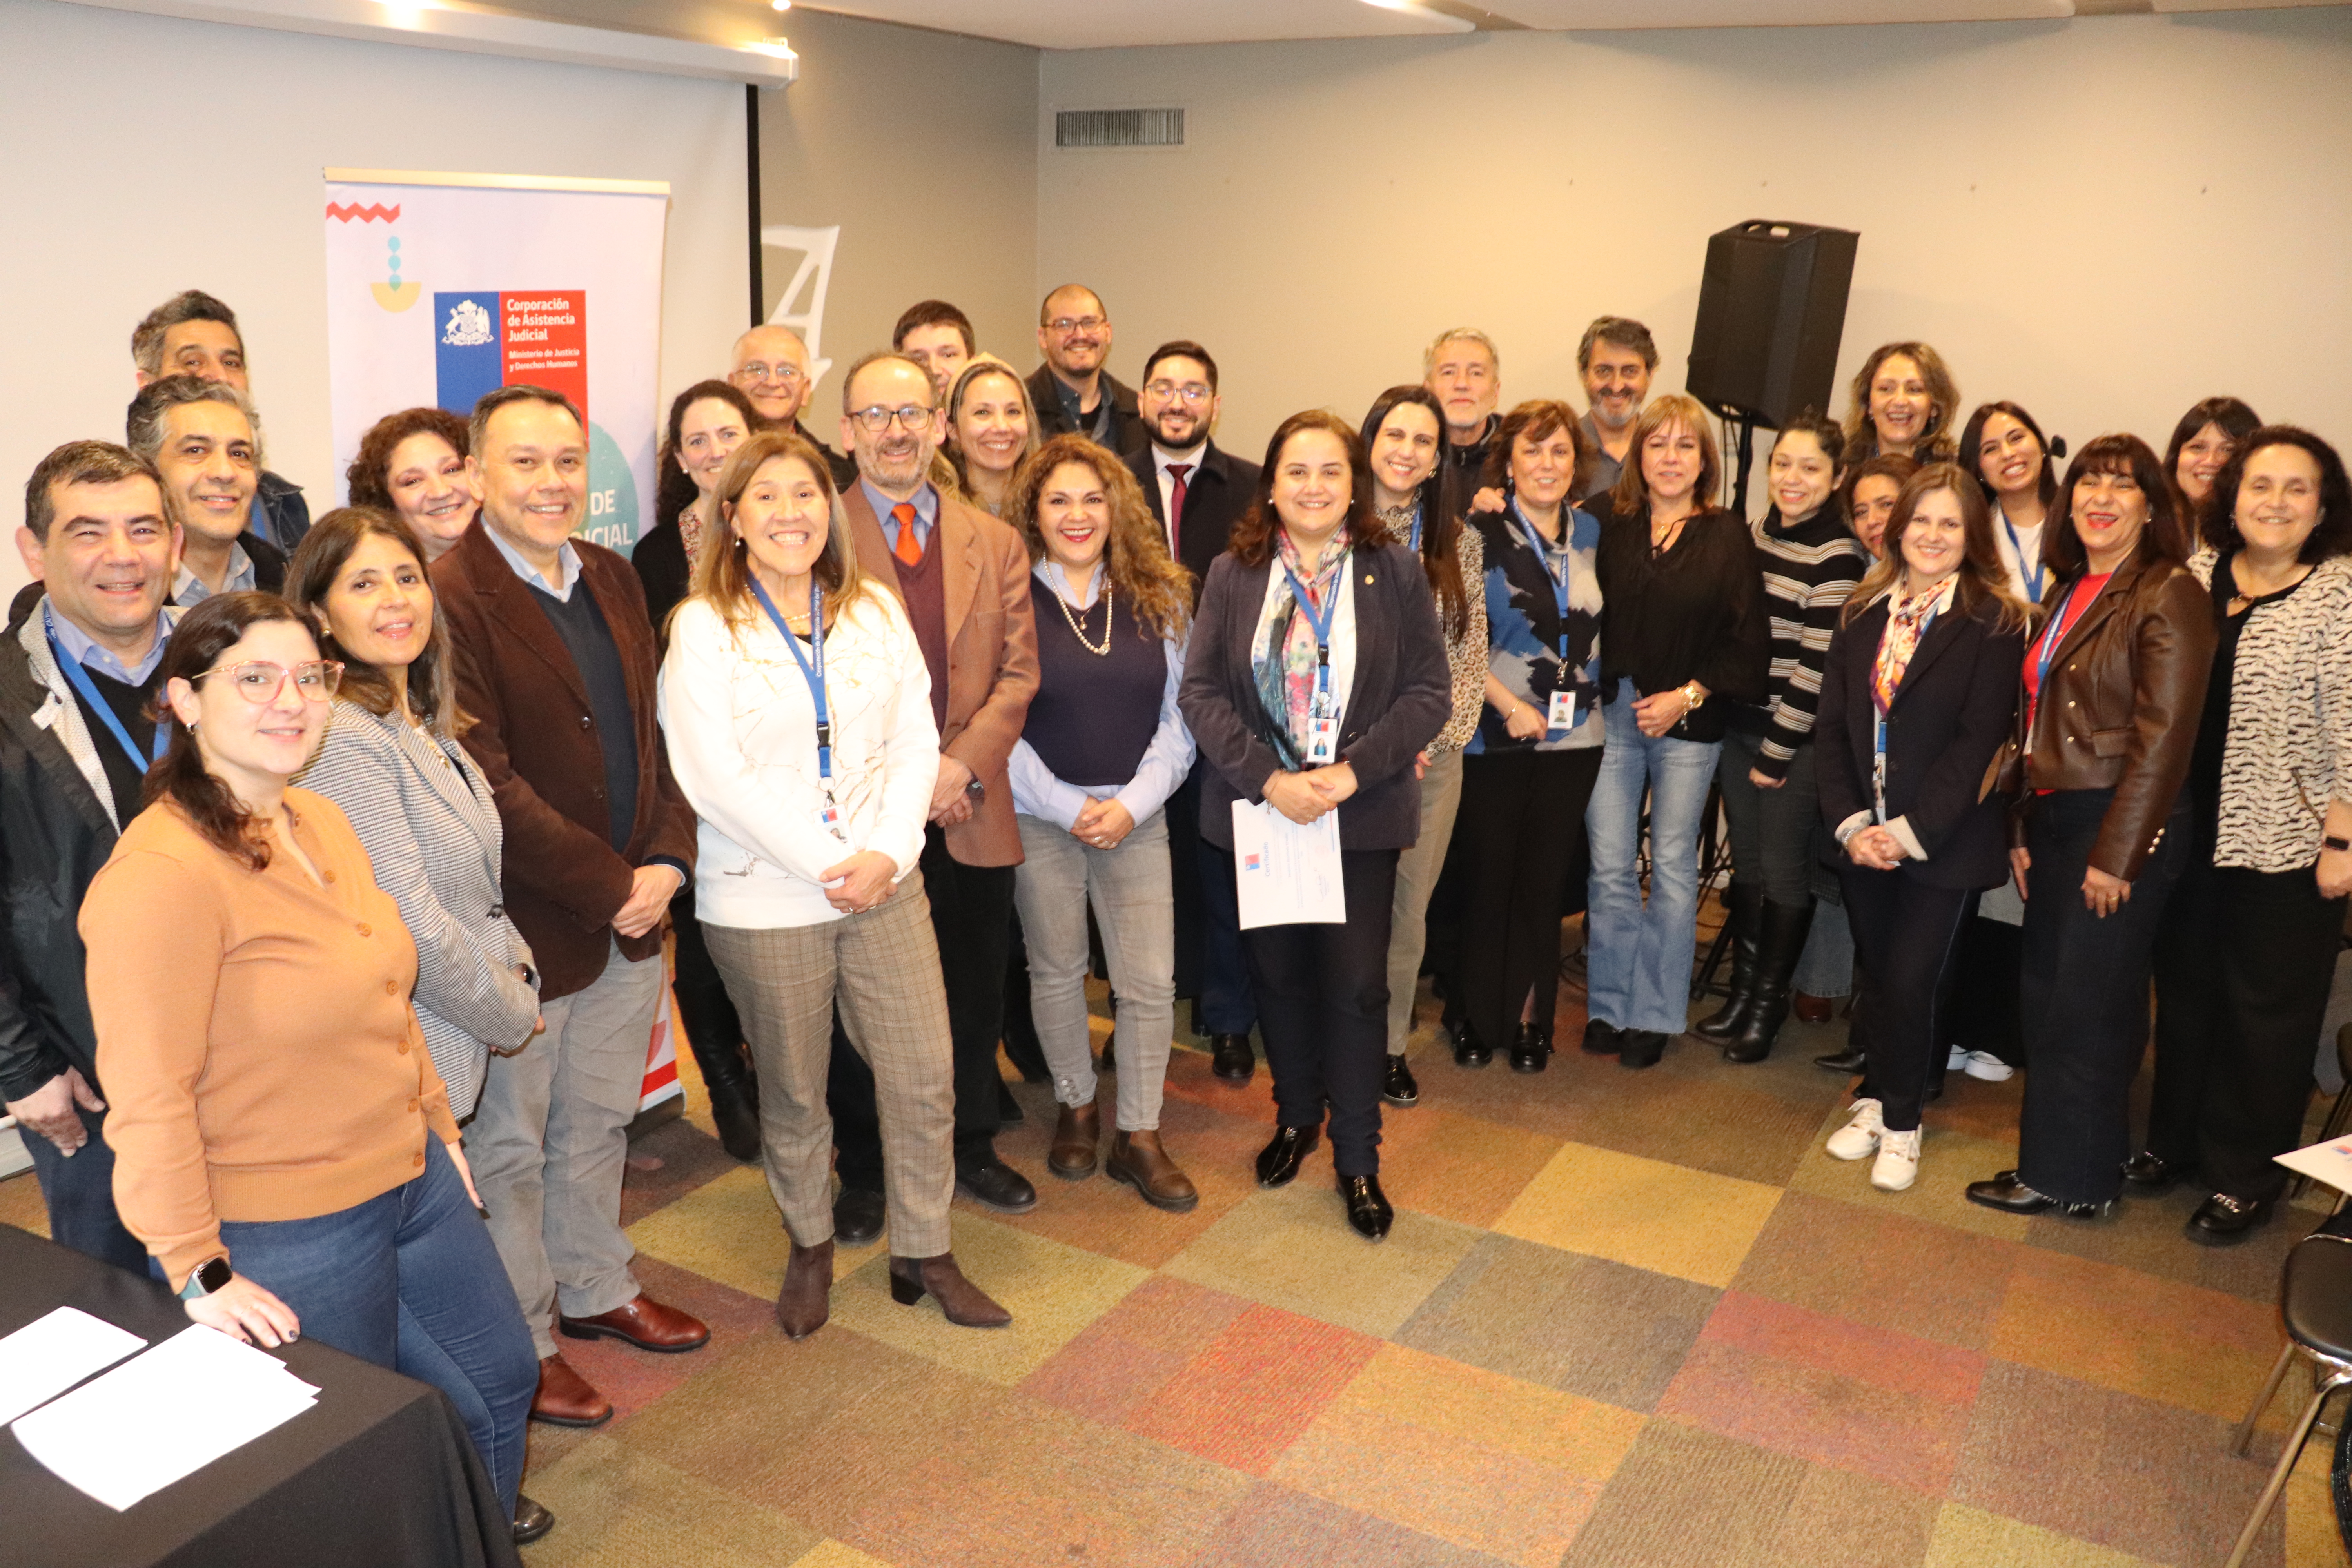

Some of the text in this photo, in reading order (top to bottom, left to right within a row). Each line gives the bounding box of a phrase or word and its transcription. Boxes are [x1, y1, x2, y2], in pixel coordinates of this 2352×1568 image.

[507, 298, 569, 313] Corporación
[508, 313, 575, 326] de Asistencia
[508, 328, 548, 342] Judicial
[509, 348, 580, 359] Ministerio de Justicia
[509, 360, 578, 372] y Derechos Humanos
[590, 489, 615, 515] DE
[570, 523, 633, 548] ICIAL
